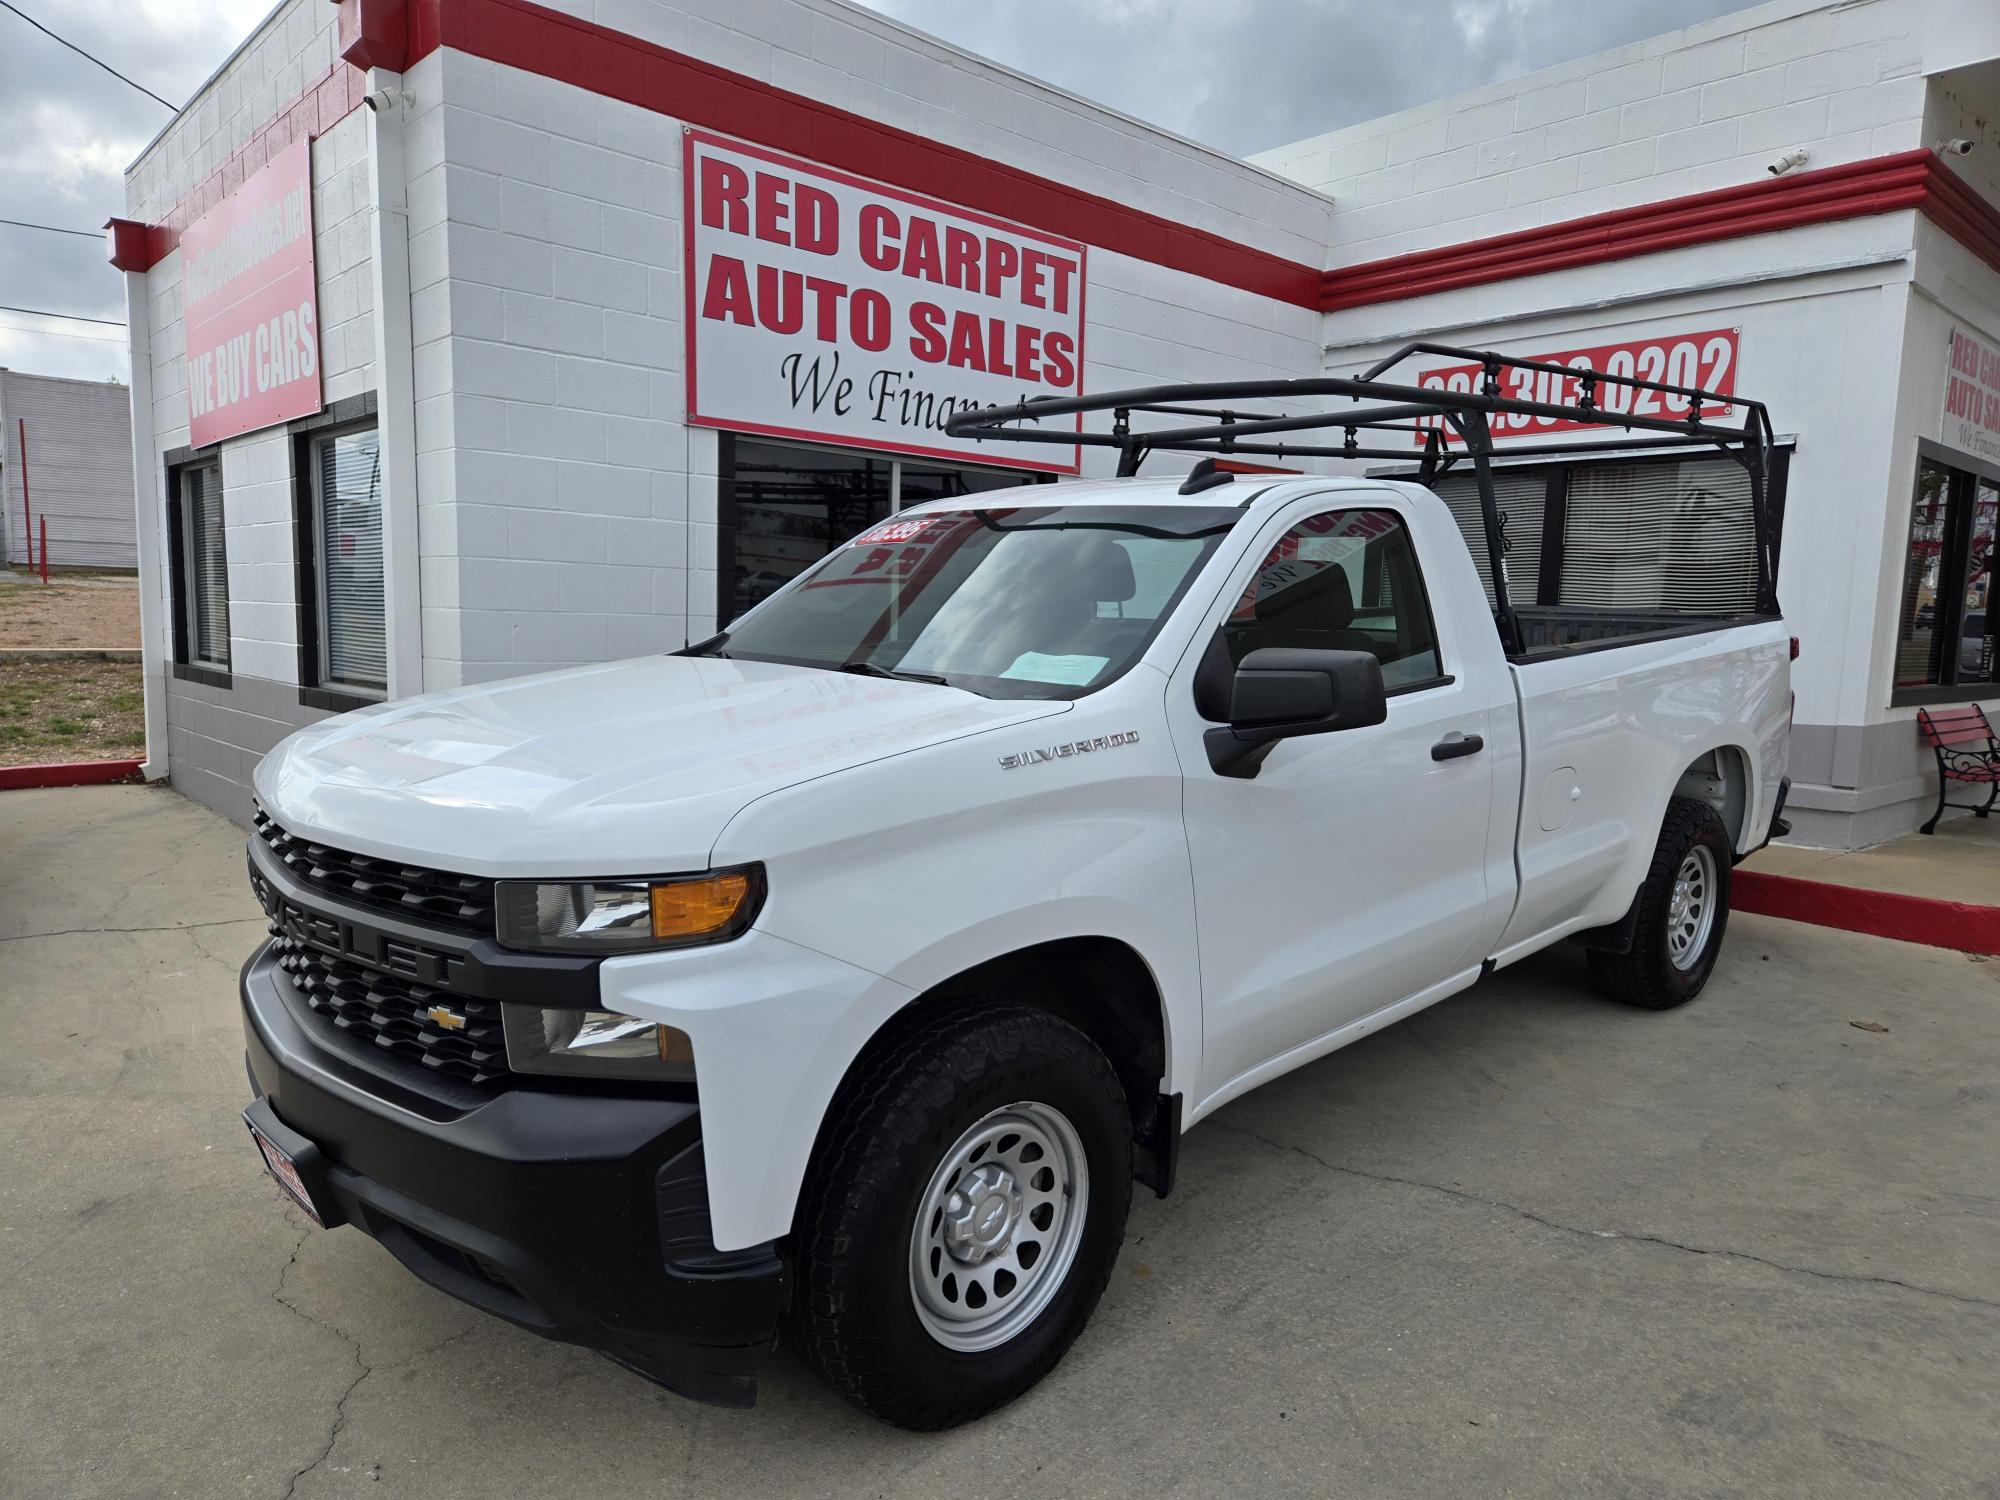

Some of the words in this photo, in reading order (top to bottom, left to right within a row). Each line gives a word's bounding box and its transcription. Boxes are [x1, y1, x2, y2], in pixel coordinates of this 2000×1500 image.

[700, 155, 839, 256] RED
[858, 203, 1078, 315] CARPET
[702, 253, 892, 353] AUTO
[909, 301, 1075, 388] SALES
[188, 350, 215, 419] WE
[215, 331, 251, 409] BUY
[254, 300, 316, 395] CARS
[780, 350, 854, 416] We
[1952, 333, 1980, 378] RED
[1946, 376, 1983, 425] AUTO
[998, 730, 1140, 771] SILVERADO
